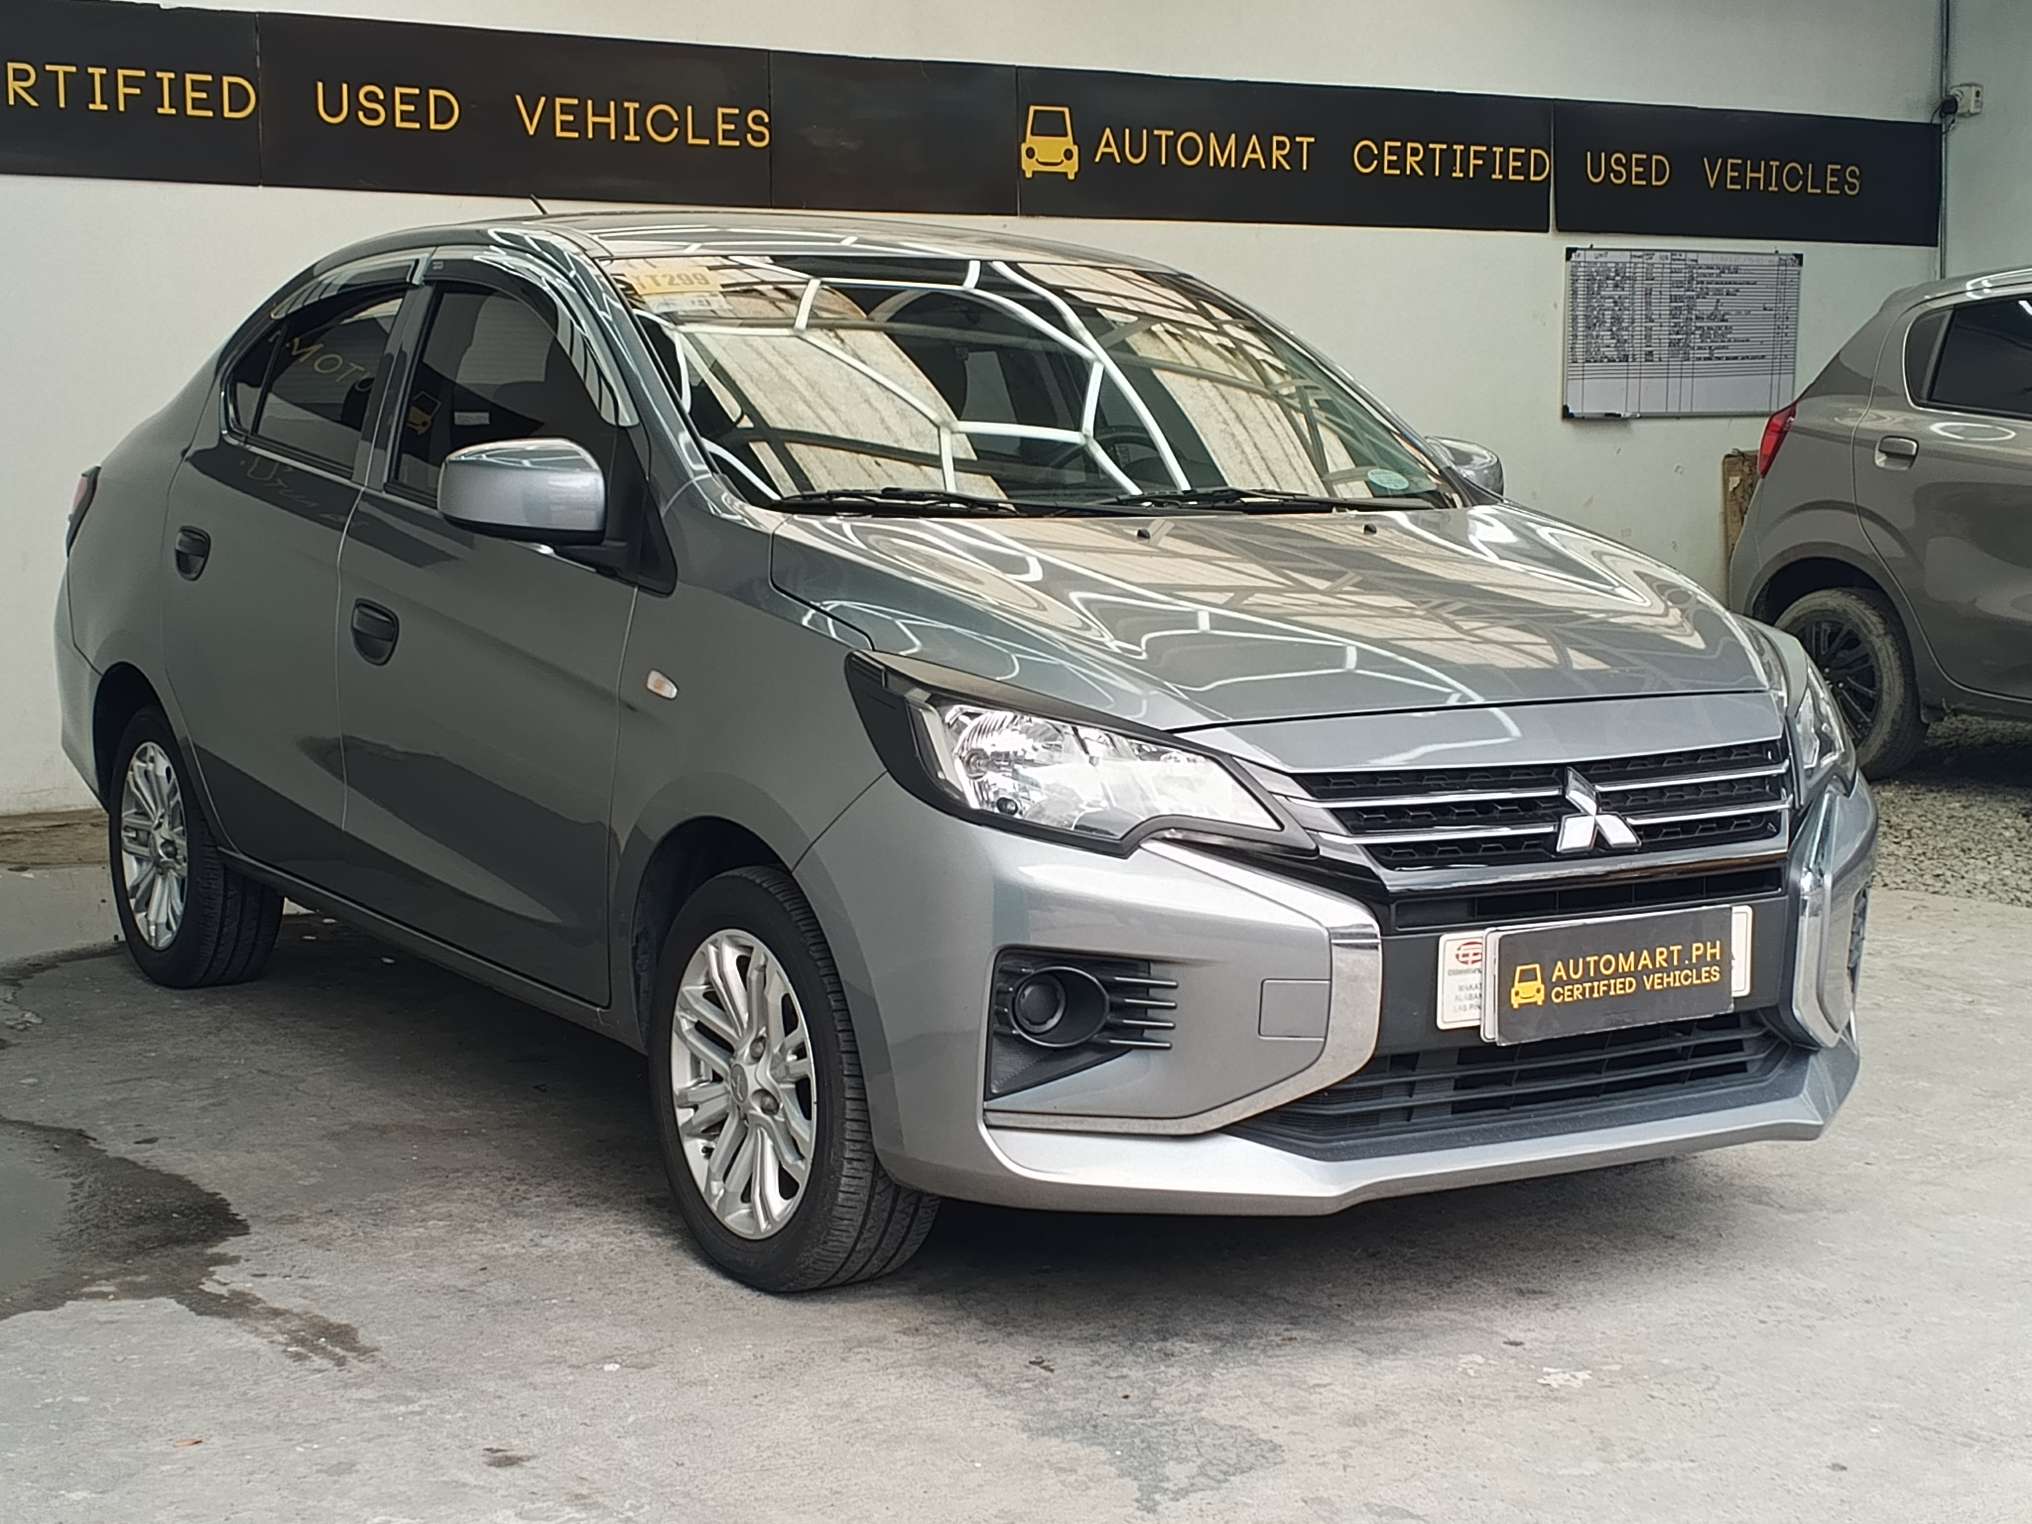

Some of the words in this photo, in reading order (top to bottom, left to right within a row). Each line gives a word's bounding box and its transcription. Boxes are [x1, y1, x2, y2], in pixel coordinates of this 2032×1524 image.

[6, 61, 257, 118] RTIFIED
[316, 81, 460, 131] USED
[515, 95, 771, 148] VEHICLES
[1094, 127, 1316, 171] AUTOMART
[1353, 139, 1550, 181] CERTIFIED
[1586, 152, 1670, 187] USED
[1704, 157, 1862, 196] VEHICLES
[1551, 940, 1721, 983] AUTOMART.PH
[1551, 976, 1637, 1004] CERTIFIED
[1644, 966, 1721, 991] VEHICLES
